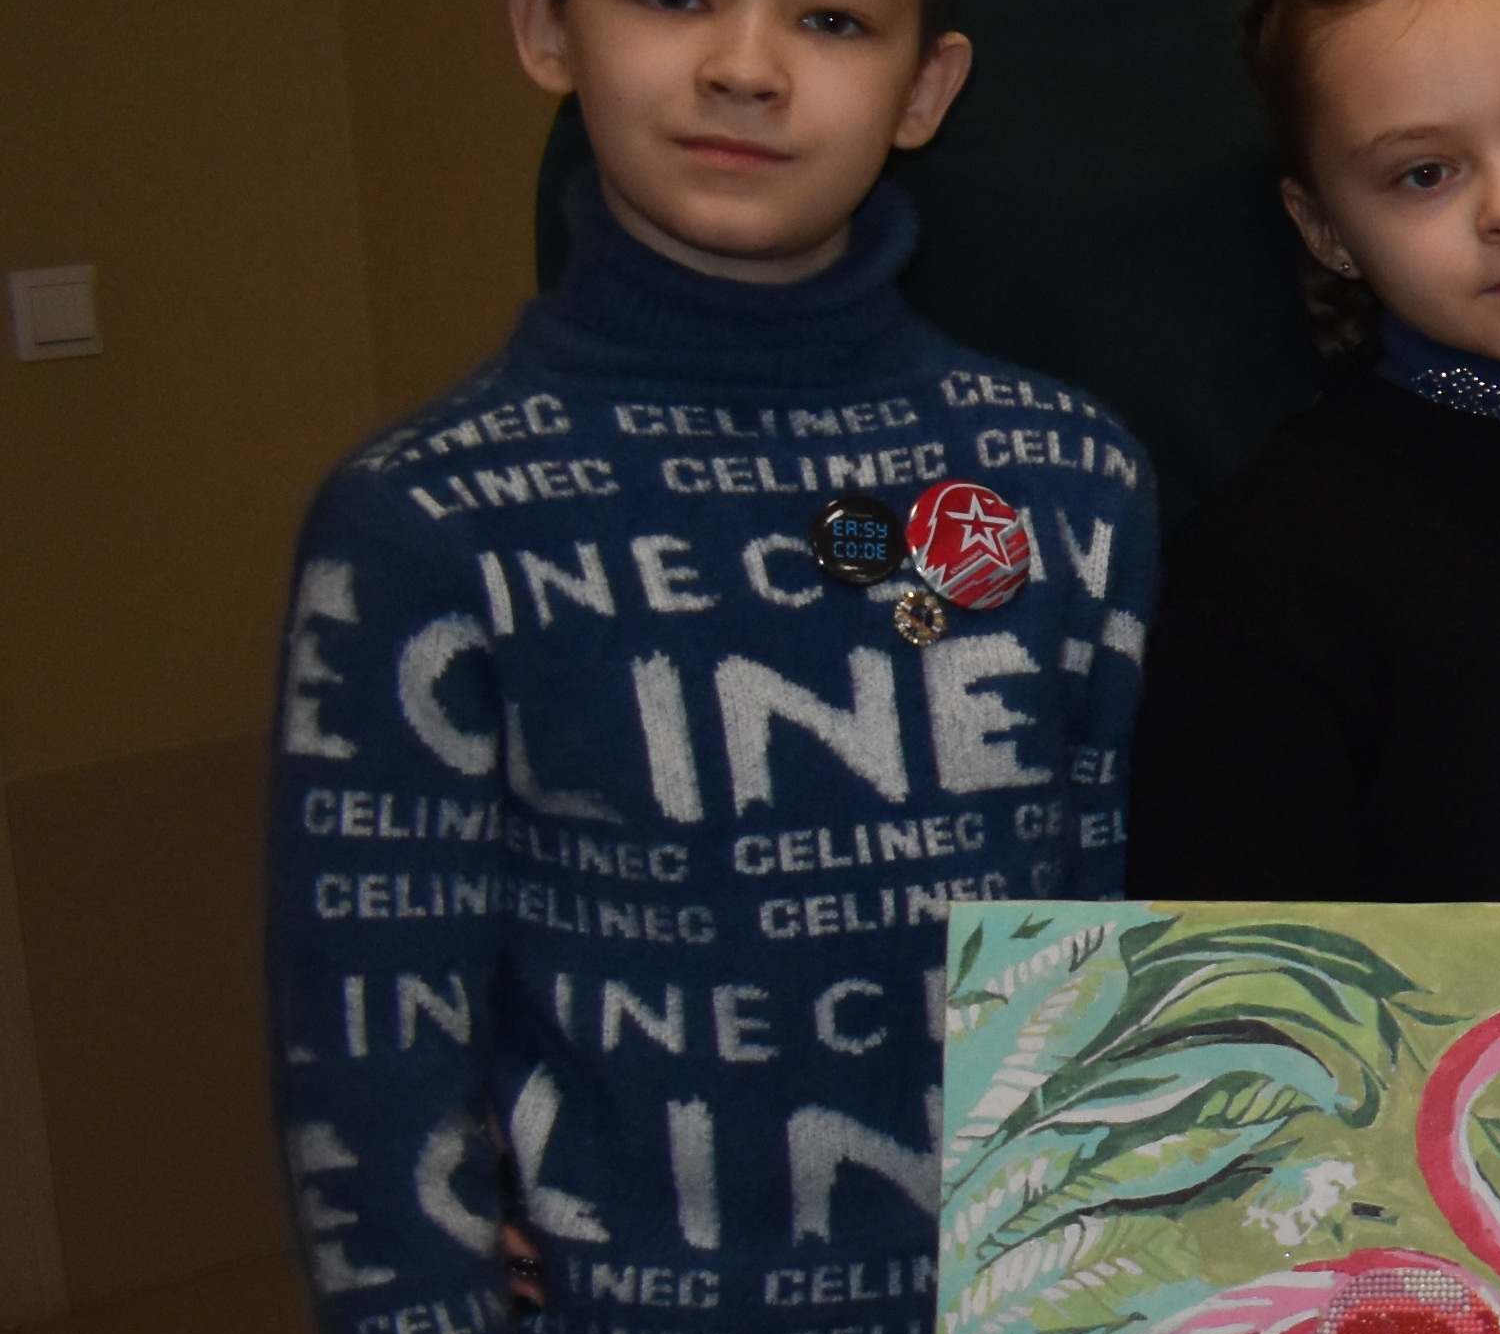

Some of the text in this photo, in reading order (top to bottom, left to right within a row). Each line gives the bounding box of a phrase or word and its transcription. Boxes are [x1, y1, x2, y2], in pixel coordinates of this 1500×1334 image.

[614, 397, 919, 438] CELINEC
[661, 441, 948, 494] CELINEC
[976, 428, 1138, 491] CELIN
[734, 812, 985, 875] CELINEC
